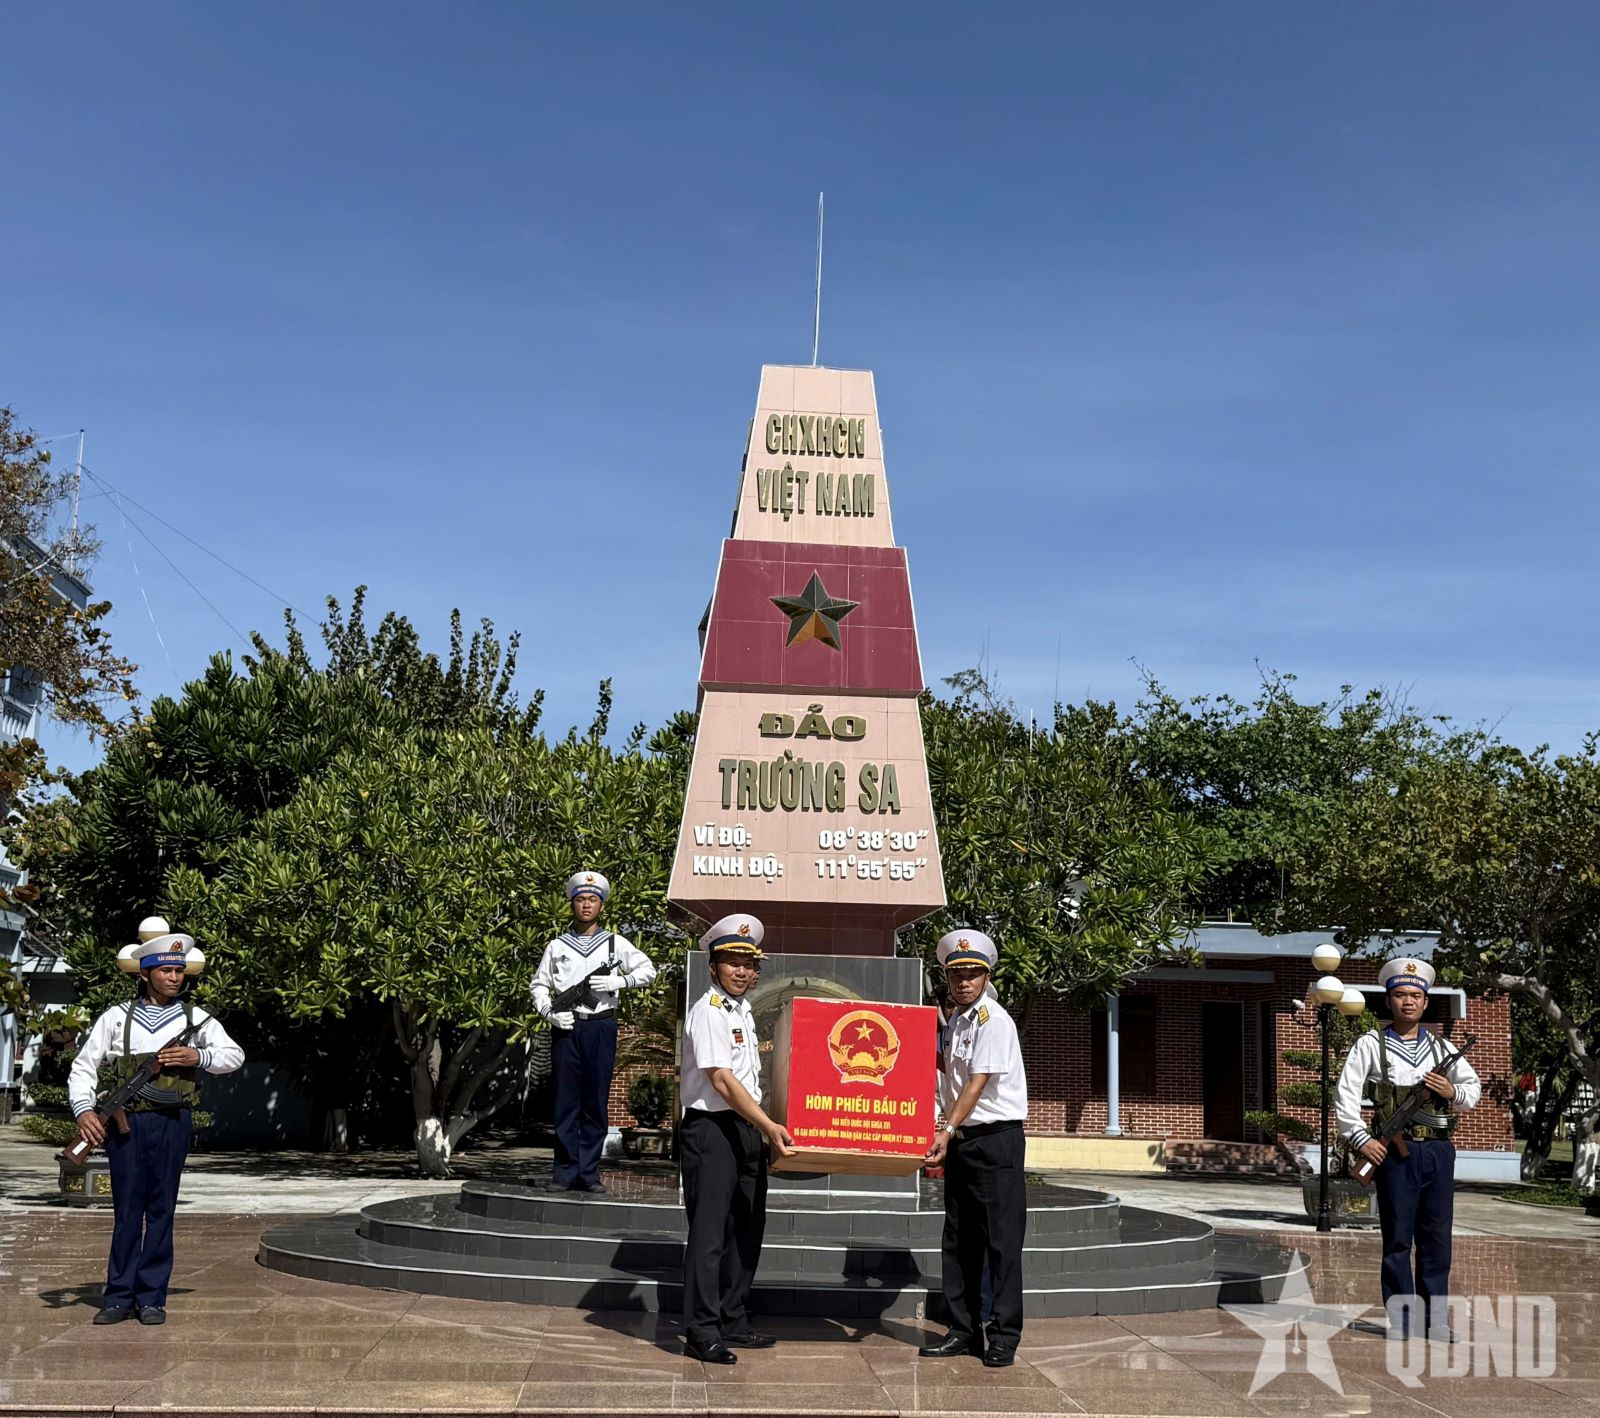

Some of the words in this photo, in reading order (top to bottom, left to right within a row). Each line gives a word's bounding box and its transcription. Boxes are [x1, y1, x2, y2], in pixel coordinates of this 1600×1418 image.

[766, 414, 865, 458] CHXHCN
[757, 461, 809, 522] VIỆT
[816, 472, 875, 518] NAM
[758, 703, 867, 741] ĐẢO
[719, 749, 846, 813] TRƯỜNG
[858, 762, 901, 814] SA
[694, 822, 715, 846] VĨ
[718, 823, 752, 851] ĐỘ:
[693, 855, 743, 876] KINH
[748, 852, 784, 883] ĐỘ:
[805, 1091, 833, 1111] HÒM
[835, 1093, 871, 1114] PHIẾU
[900, 1096, 918, 1117] CỬ
